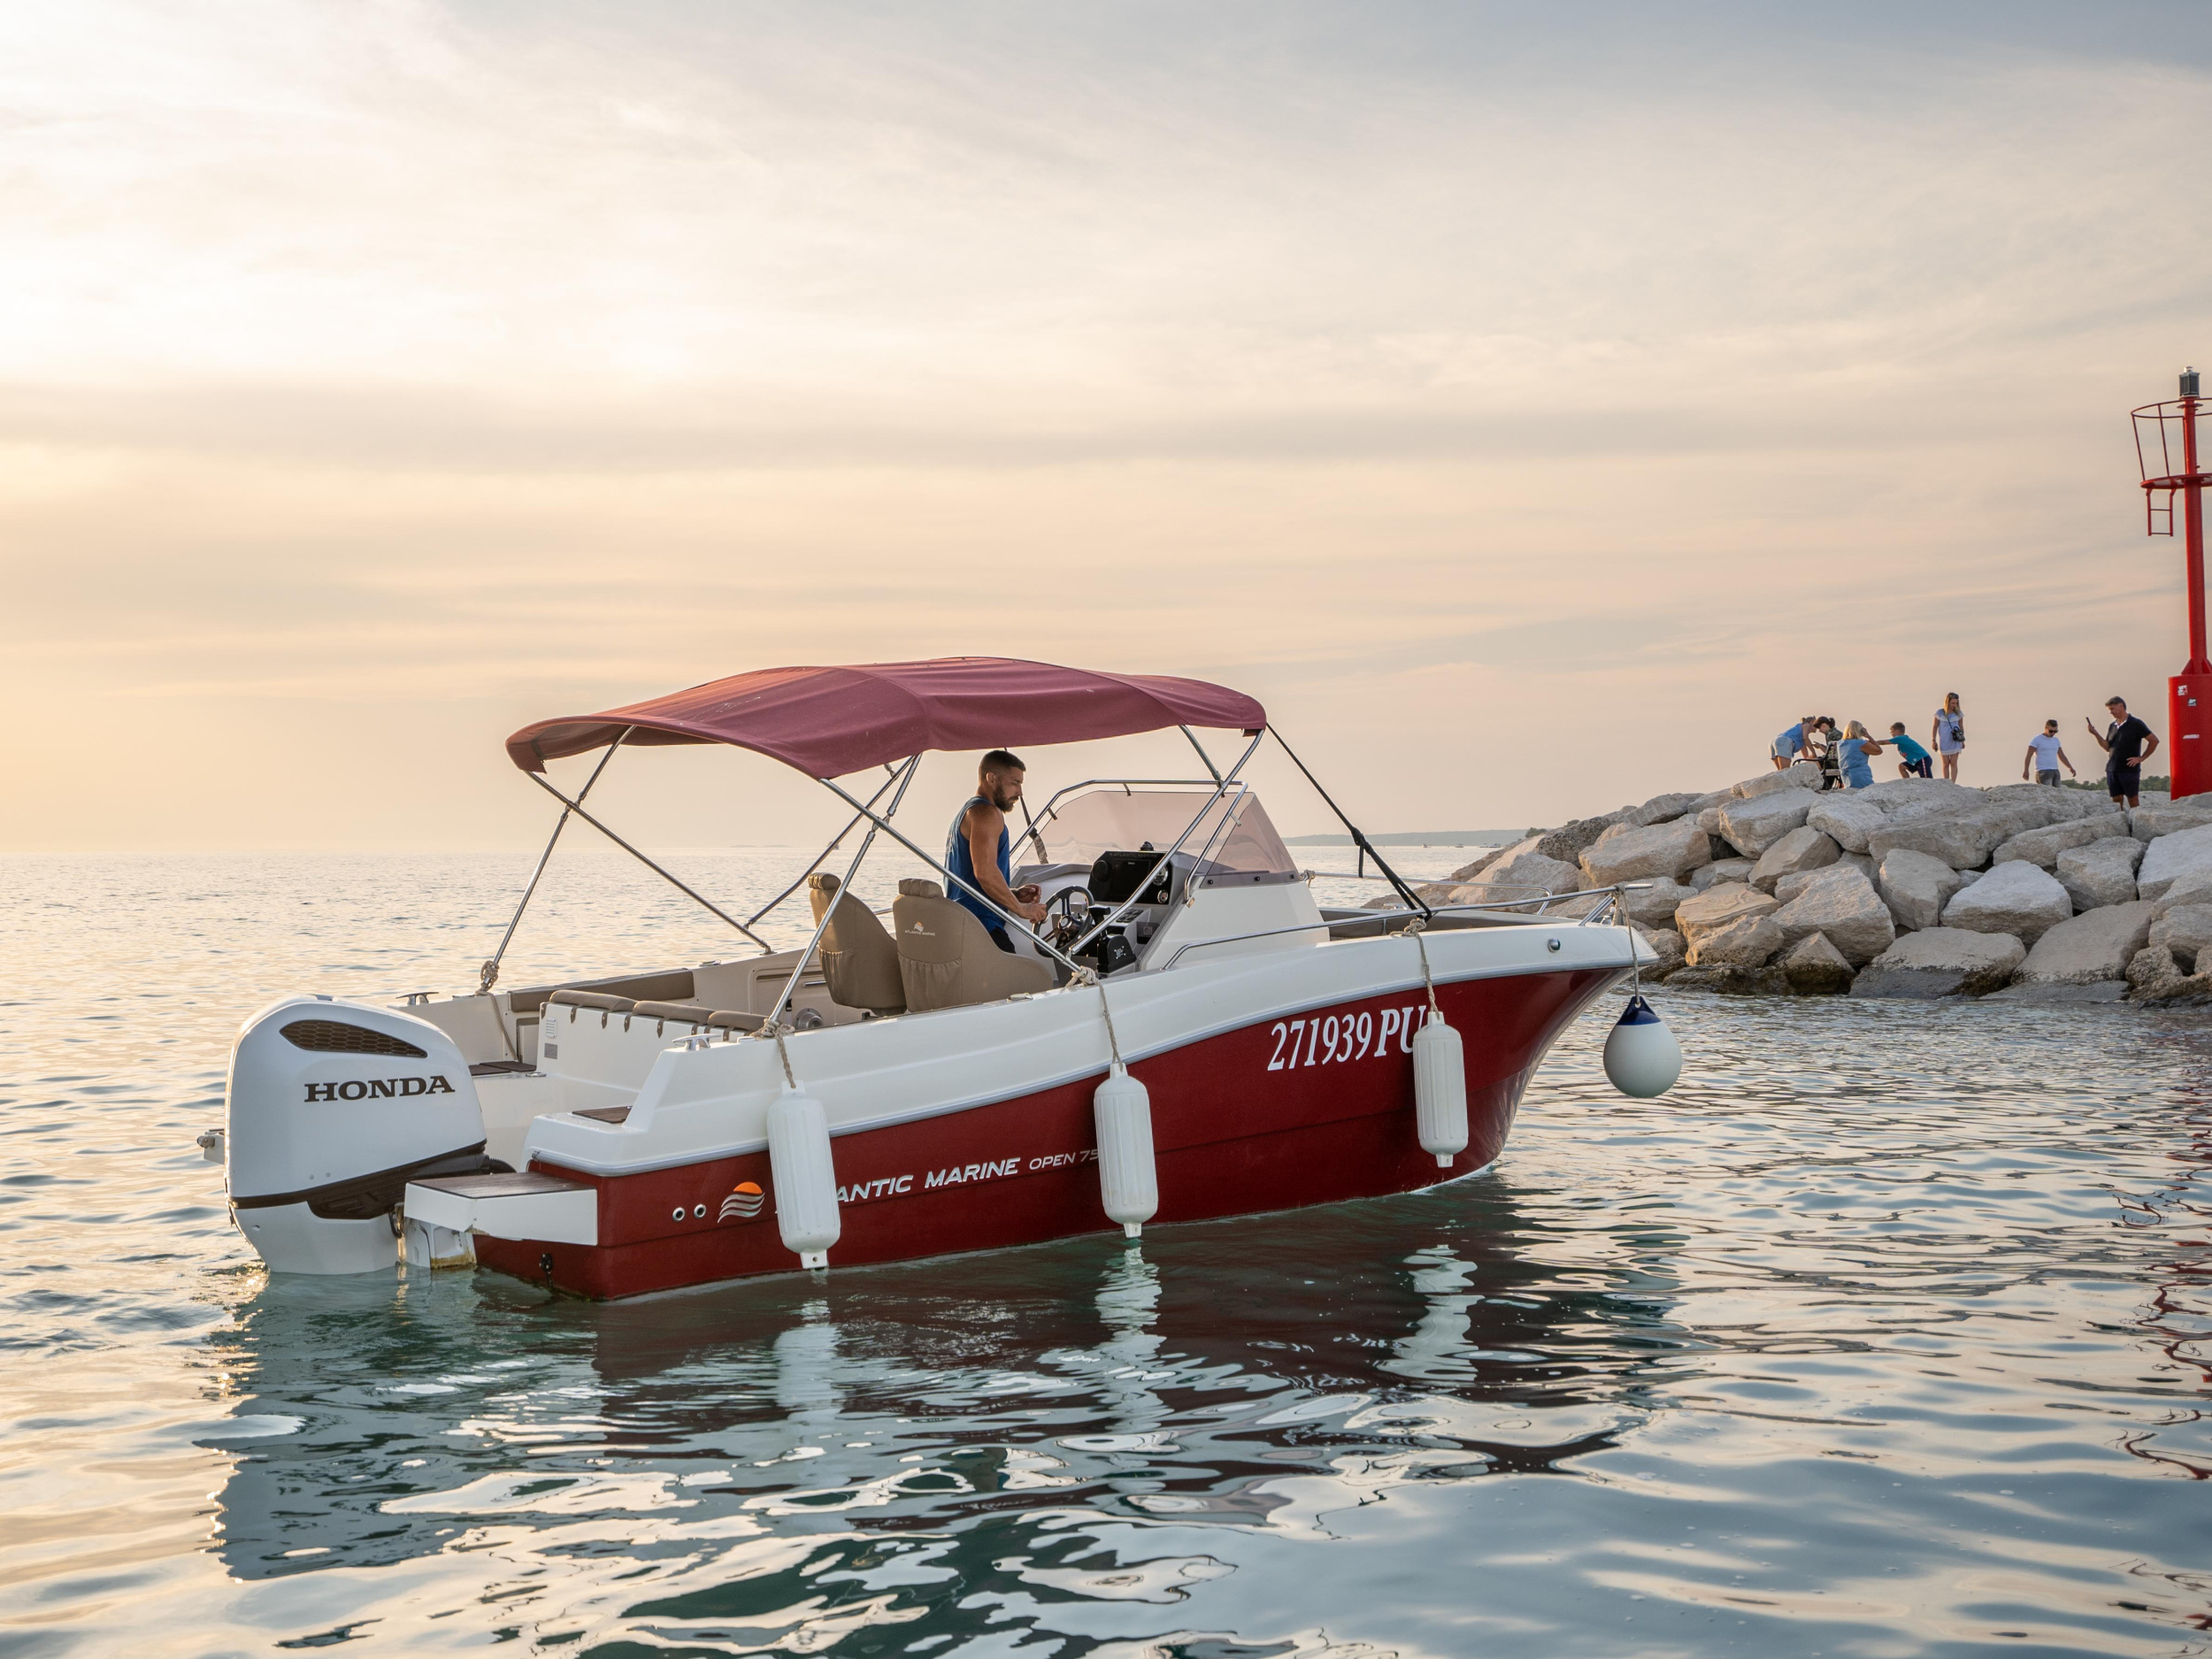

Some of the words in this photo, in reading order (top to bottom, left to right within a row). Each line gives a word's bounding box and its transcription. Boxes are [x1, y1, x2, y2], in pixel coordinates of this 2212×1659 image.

[303, 1075, 456, 1102] HONDA
[836, 1174, 914, 1202] ANTIC
[924, 1157, 1021, 1189] MARINE
[1029, 1152, 1076, 1171] OPEN
[1079, 1148, 1100, 1164] 75
